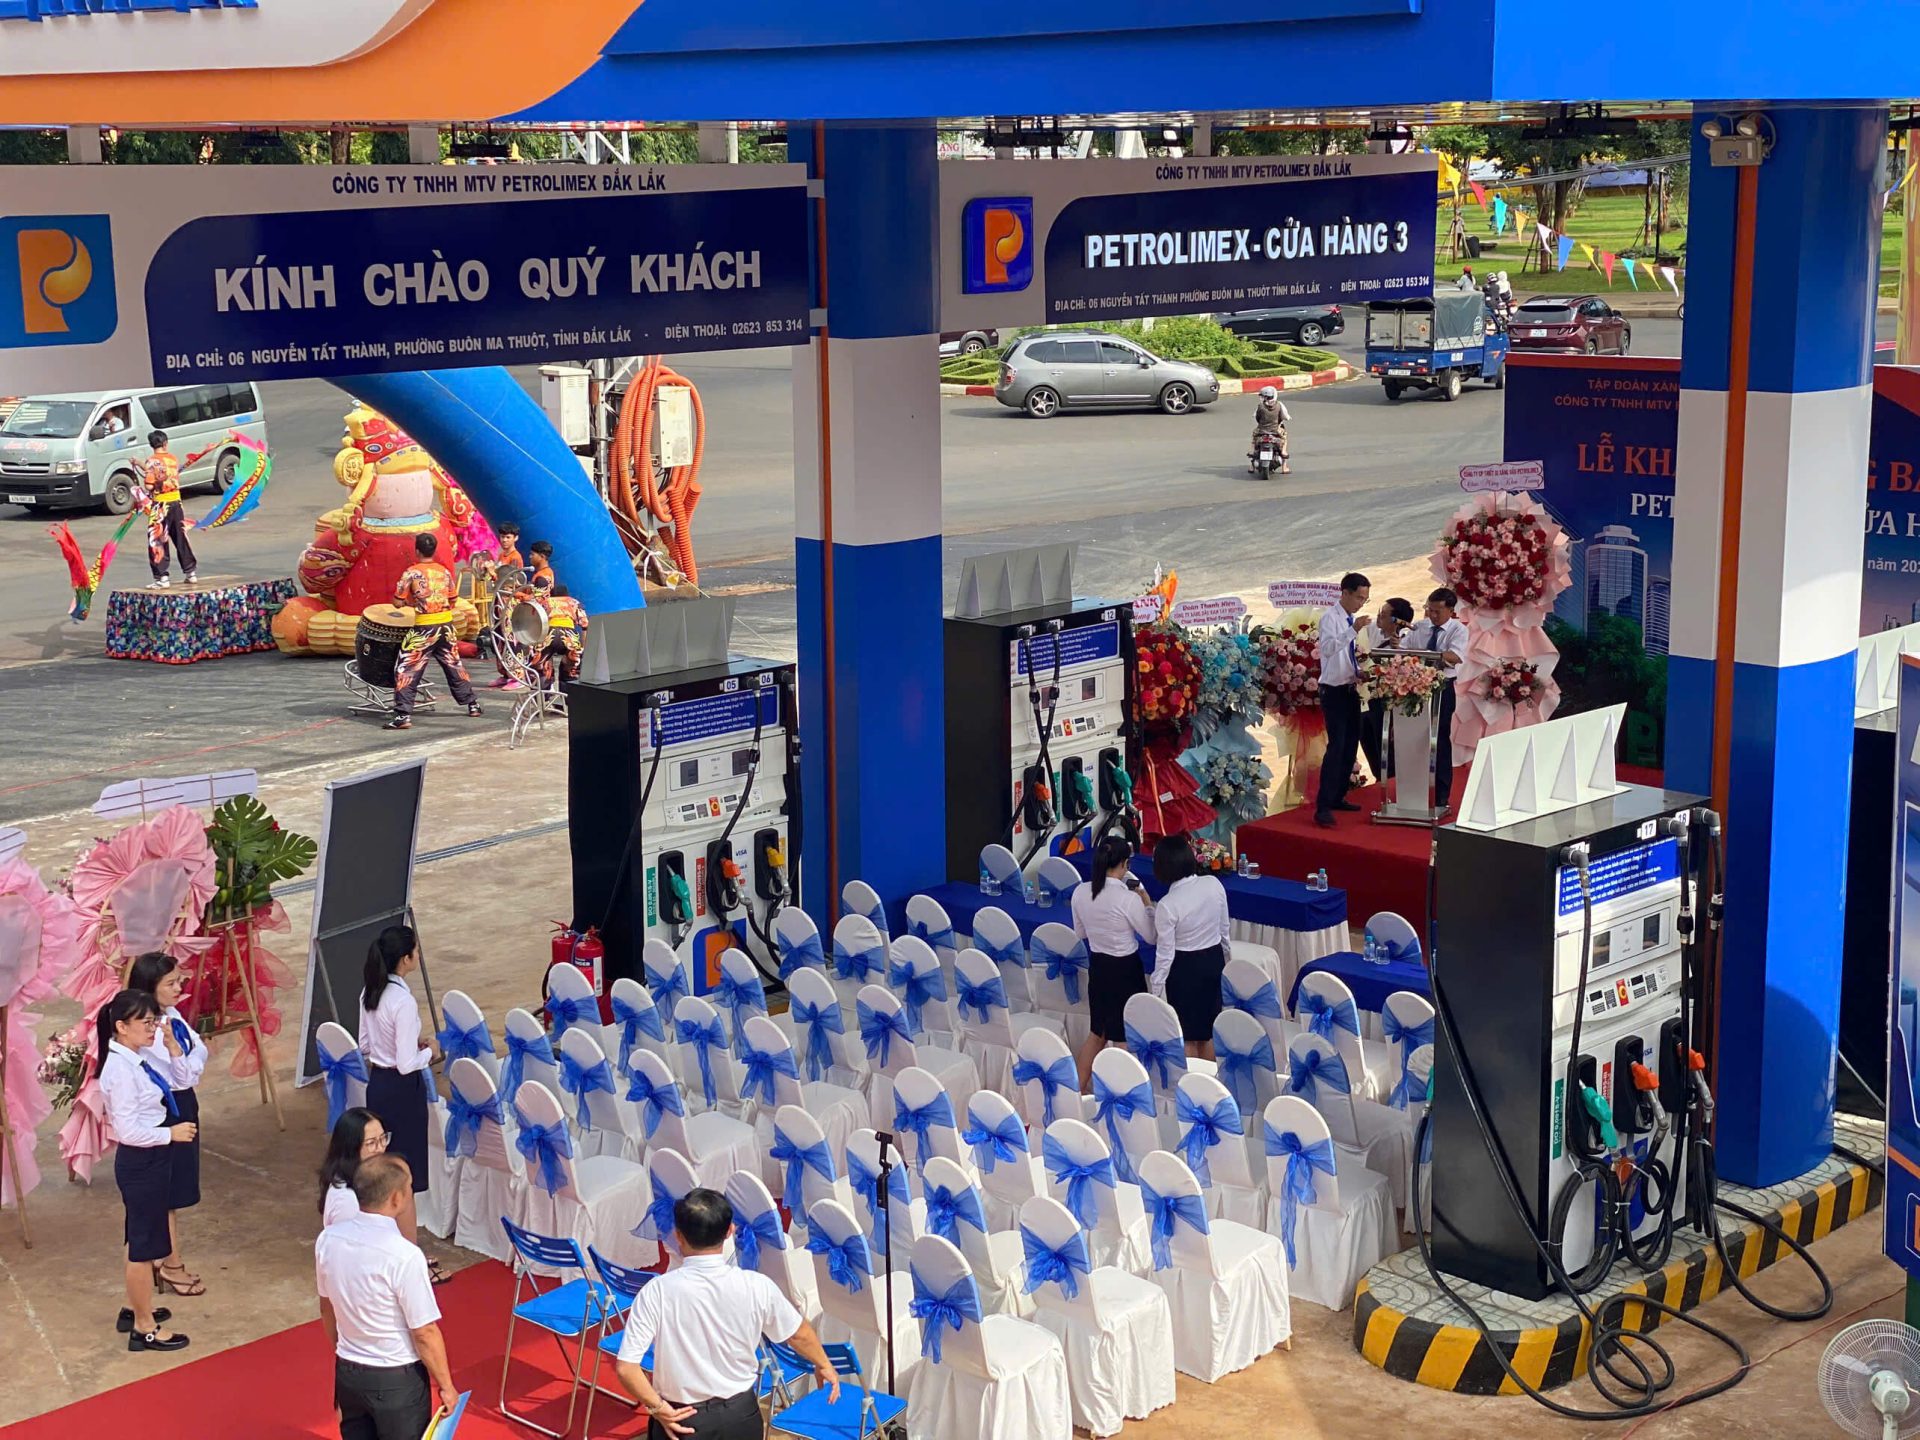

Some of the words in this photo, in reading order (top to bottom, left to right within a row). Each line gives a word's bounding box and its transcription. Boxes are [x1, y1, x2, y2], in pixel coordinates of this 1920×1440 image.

[1156, 163, 1183, 180] CÔNG
[1187, 166, 1200, 180] TY
[1202, 165, 1229, 179] TNHH
[1231, 164, 1252, 178] MTV
[1254, 163, 1310, 178] PETROLIMEX
[1313, 159, 1332, 177] ĐẮK
[1334, 159, 1352, 176] LẮK
[332, 171, 379, 194] CÔNG
[385, 175, 406, 193] TY
[414, 175, 457, 193] TNHH
[464, 174, 496, 192] MTV
[502, 174, 597, 192] PETROLIMEX
[602, 168, 632, 191] ĐẮK
[638, 168, 666, 191] LẮK
[1321, 215, 1388, 256] HÀNG
[1393, 221, 1408, 252] 3
[215, 255, 336, 312] KÍNH
[362, 249, 489, 306] CHÀO
[519, 246, 605, 301] QUÝ
[630, 241, 761, 293] KHÁCH
[1088, 298, 1098, 309] 06
[1100, 292, 1133, 308] NGUYỄN
[1135, 291, 1150, 305] TẤT
[1152, 291, 1178, 304] THÀNH
[1180, 288, 1210, 302] PHƯỜNG
[1212, 286, 1232, 301] BUÔN
[1234, 288, 1244, 299] MA
[1247, 283, 1270, 299] THUỘT
[1290, 279, 1305, 295] ĐẮK
[1307, 279, 1320, 294] LẮK
[1341, 279, 1357, 293] ĐIỆN
[1384, 277, 1404, 289] 02623
[1406, 276, 1418, 287] 853
[1418, 275, 1430, 287] 314
[166, 354, 190, 373] ĐỊA
[228, 353, 245, 366] 06
[251, 342, 307, 364] NGUYỄN
[311, 342, 338, 361] TẤT
[343, 341, 390, 360] THÀNH,
[394, 337, 444, 356] PHƯỜNG
[449, 336, 482, 352] BUÔN
[486, 336, 504, 350] MA
[507, 333, 549, 351] THUỘT,
[553, 328, 579, 346] TỈNH
[583, 325, 606, 344] ĐẮK
[610, 324, 632, 343] LẮK
[665, 323, 690, 343] ĐIỆN
[693, 325, 727, 341] THOẠI:
[732, 321, 761, 336] 02623
[766, 319, 783, 333] 853
[786, 318, 803, 332] 314
[1588, 377, 1611, 392] TẬP
[1614, 379, 1649, 391] ĐOÀN
[1554, 393, 1589, 407] CÔNG
[1592, 397, 1607, 408] TY
[1611, 398, 1643, 409] TNHH
[1646, 400, 1672, 410] MTV
[1578, 432, 1615, 473] LỄ
[1623, 446, 1676, 477] KH
[1867, 557, 1896, 572] năm
[1107, 610, 1114, 619] 12
[726, 680, 736, 690] 05
[761, 674, 770, 684] 06
[1644, 823, 1654, 836] 17
